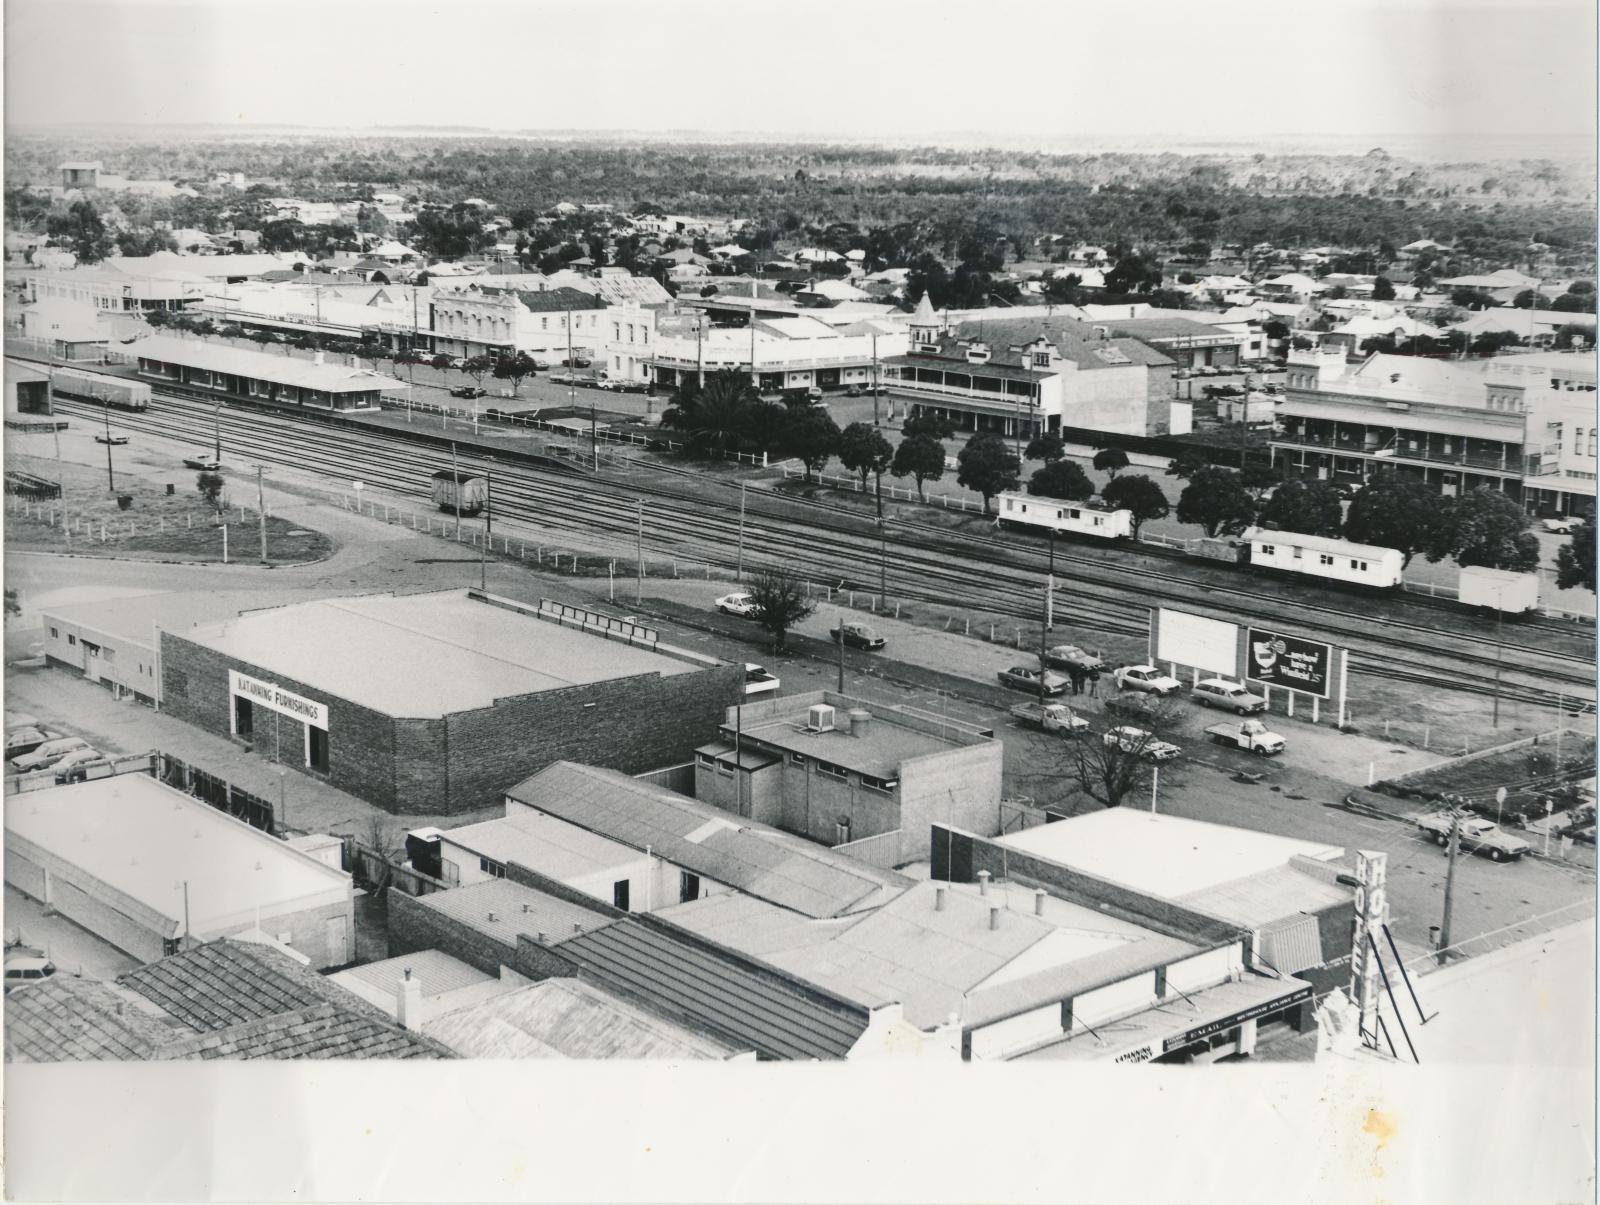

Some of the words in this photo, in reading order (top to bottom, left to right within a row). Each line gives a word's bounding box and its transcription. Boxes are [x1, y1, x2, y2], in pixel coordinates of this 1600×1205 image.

[238, 678, 272, 702] KATANNING
[275, 692, 319, 719] FURNISHINGS
[1350, 854, 1367, 1007] HOTEL
[1190, 1023, 1221, 1040] EMAIL
